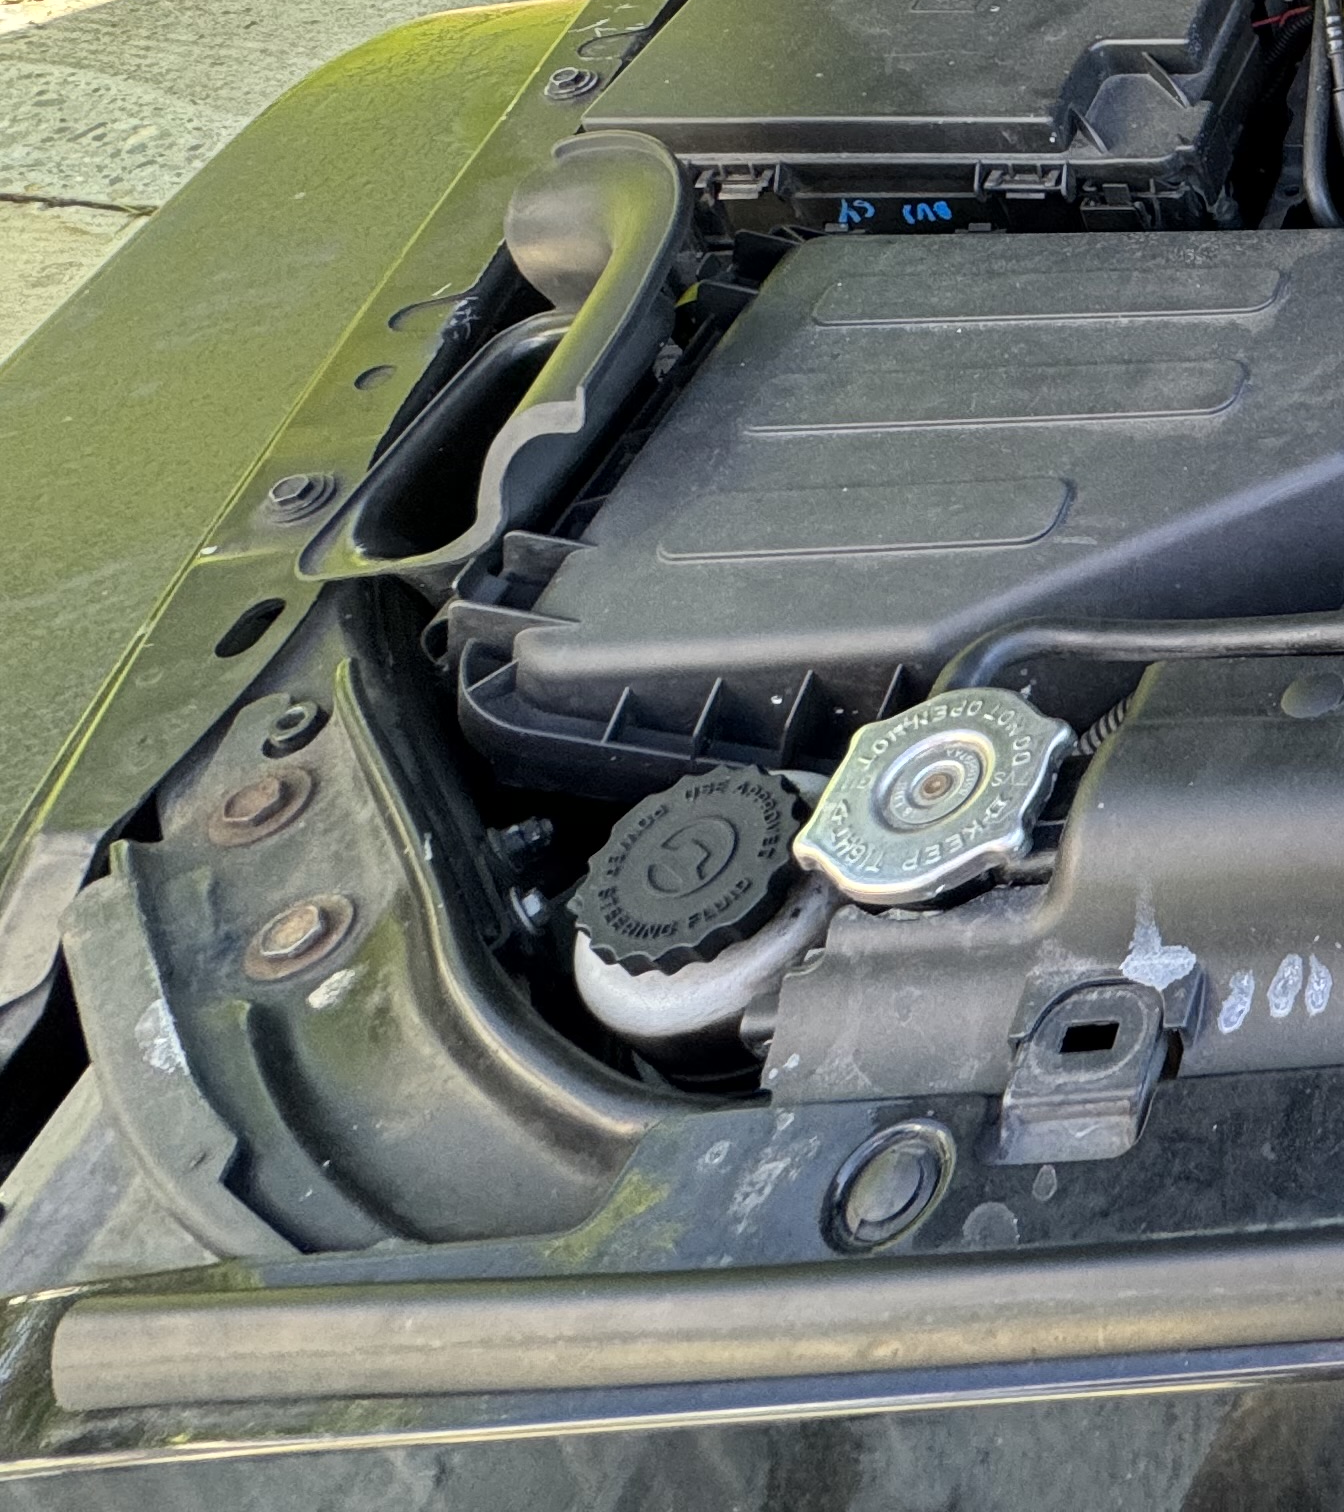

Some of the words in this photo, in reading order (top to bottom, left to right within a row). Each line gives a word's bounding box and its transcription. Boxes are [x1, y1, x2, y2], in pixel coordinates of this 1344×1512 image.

[983, 704, 1026, 739] NOT
[1011, 735, 1032, 767] DO
[901, 819, 985, 872] KEEP
